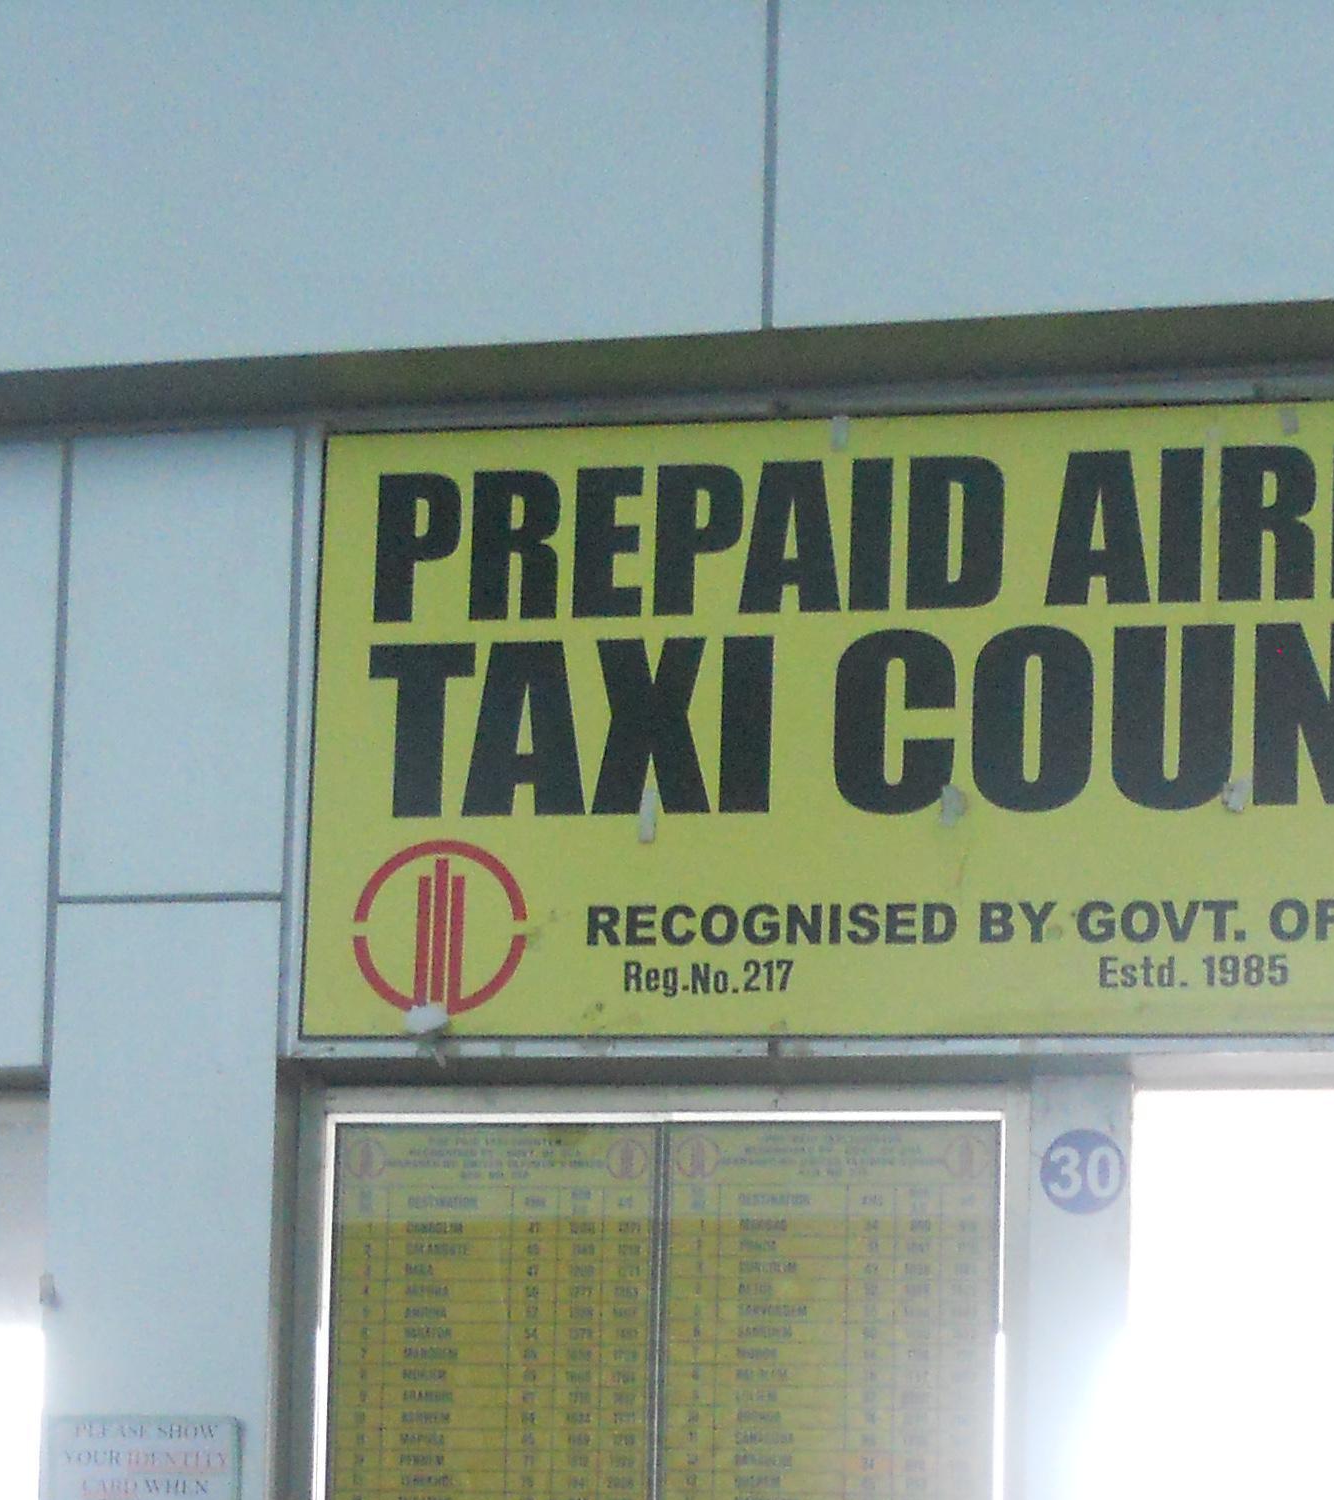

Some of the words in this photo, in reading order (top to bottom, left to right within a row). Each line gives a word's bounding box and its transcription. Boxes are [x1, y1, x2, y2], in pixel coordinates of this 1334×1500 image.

[371, 455, 1006, 623] PREPAID
[369, 635, 771, 818] TAXI
[586, 903, 957, 946] RECOGNISED
[979, 901, 1057, 944] BY
[1076, 899, 1246, 944] GOVT.
[1098, 954, 1188, 989] Estd.
[1202, 952, 1289, 988] 1985
[1049, 1145, 1121, 1200] 30
[75, 1424, 147, 1439] PLEASE
[157, 1423, 219, 1439] SHOW
[65, 1450, 121, 1466] YOUR
[145, 1479, 209, 1495] WHEN
